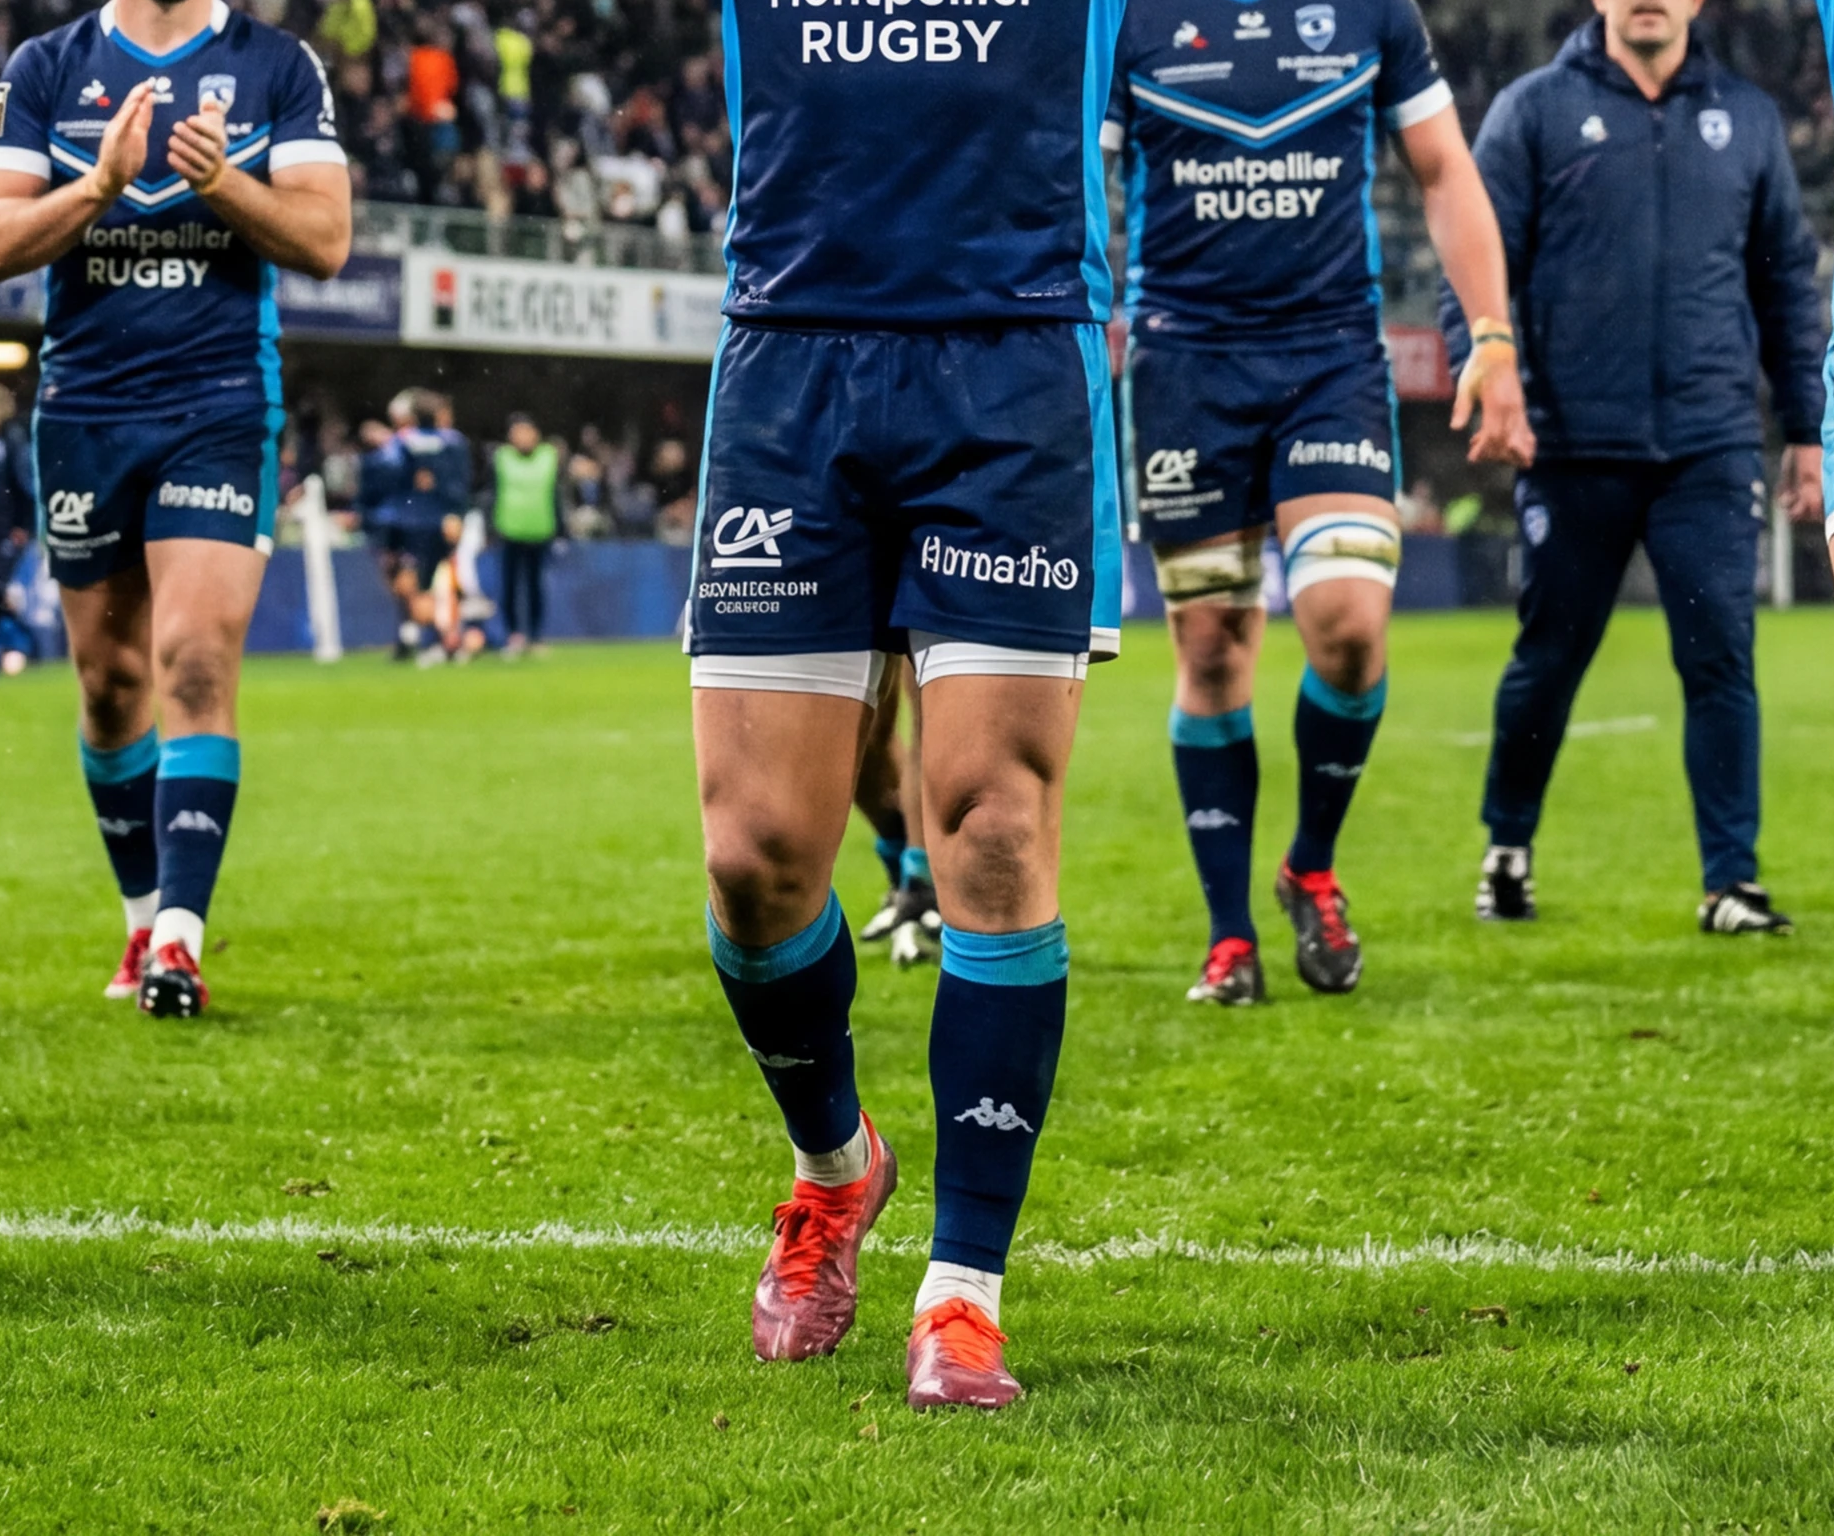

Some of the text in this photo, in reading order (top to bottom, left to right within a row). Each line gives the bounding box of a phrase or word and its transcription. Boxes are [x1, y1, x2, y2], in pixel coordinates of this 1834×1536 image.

[802, 20, 1003, 63] RUGBY
[1173, 151, 1343, 189] Montpellier
[1195, 187, 1324, 220] RUGBY
[86, 257, 209, 288] RUGBY
